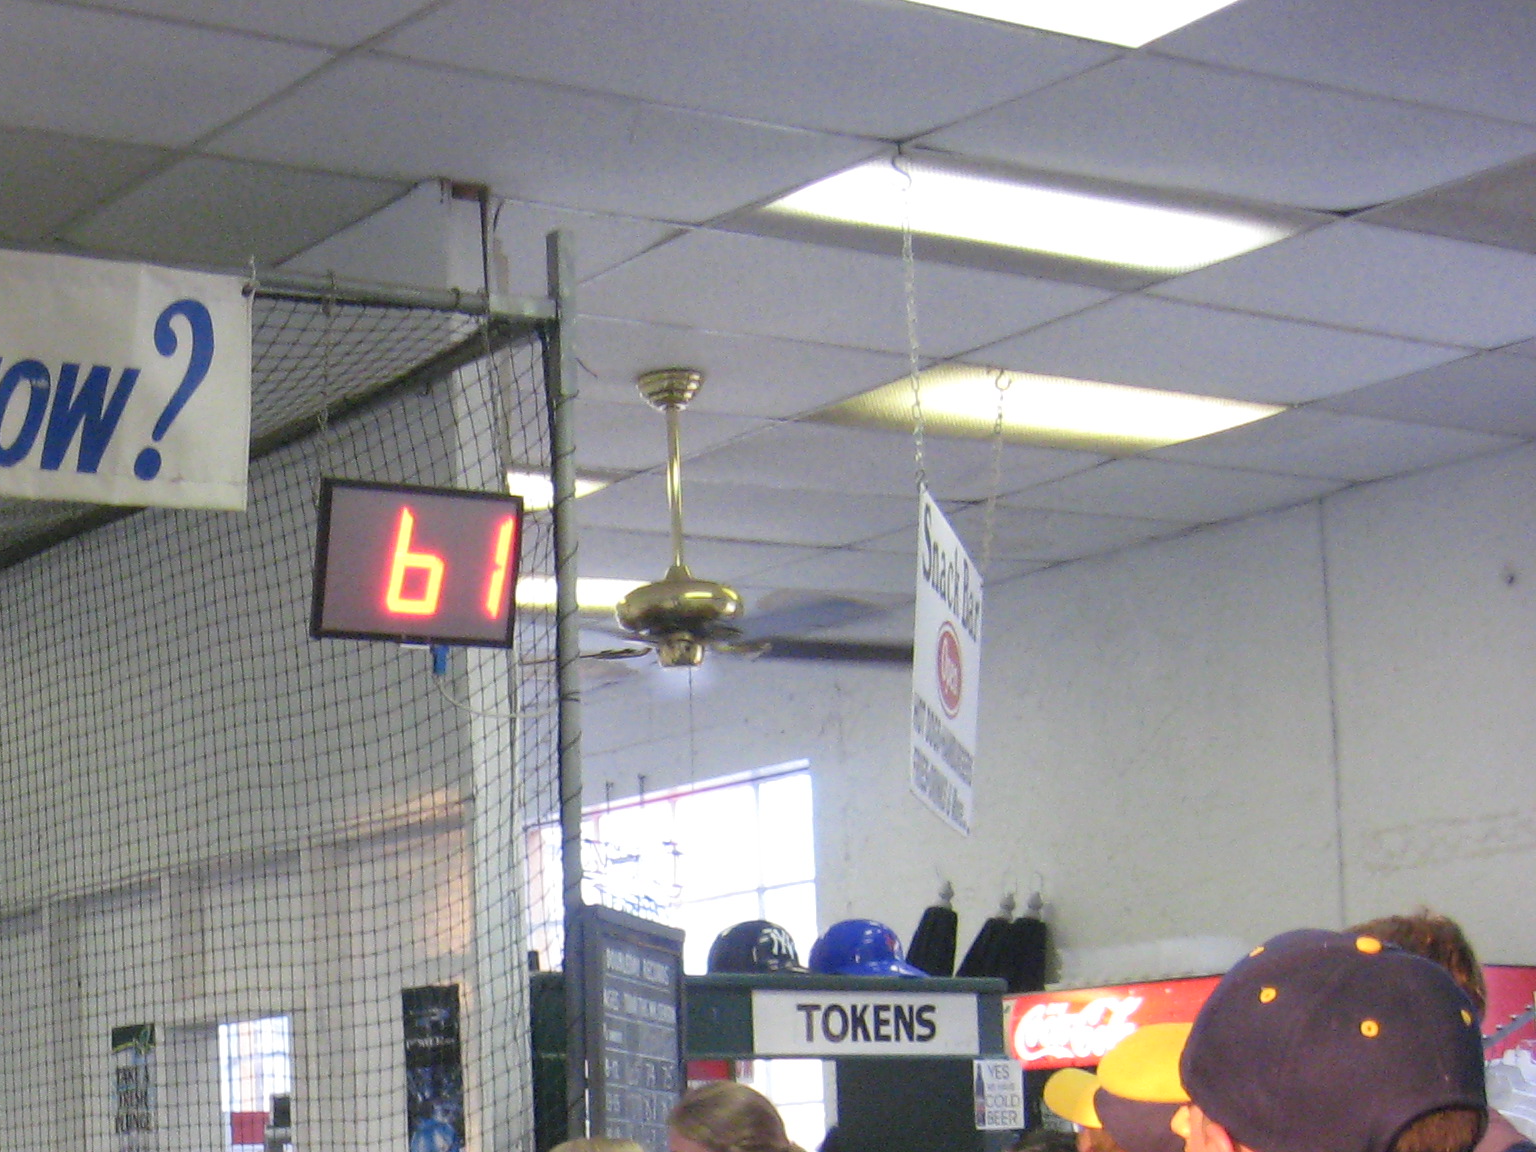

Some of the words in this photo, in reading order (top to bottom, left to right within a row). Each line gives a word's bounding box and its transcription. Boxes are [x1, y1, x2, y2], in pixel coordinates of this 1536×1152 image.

[922, 503, 960, 619] Snack
[962, 557, 980, 642] Bar
[796, 1003, 938, 1042] TOKENS
[987, 1064, 1010, 1080] YES
[987, 1094, 1020, 1108] COLD
[987, 1110, 1017, 1126] BEER
